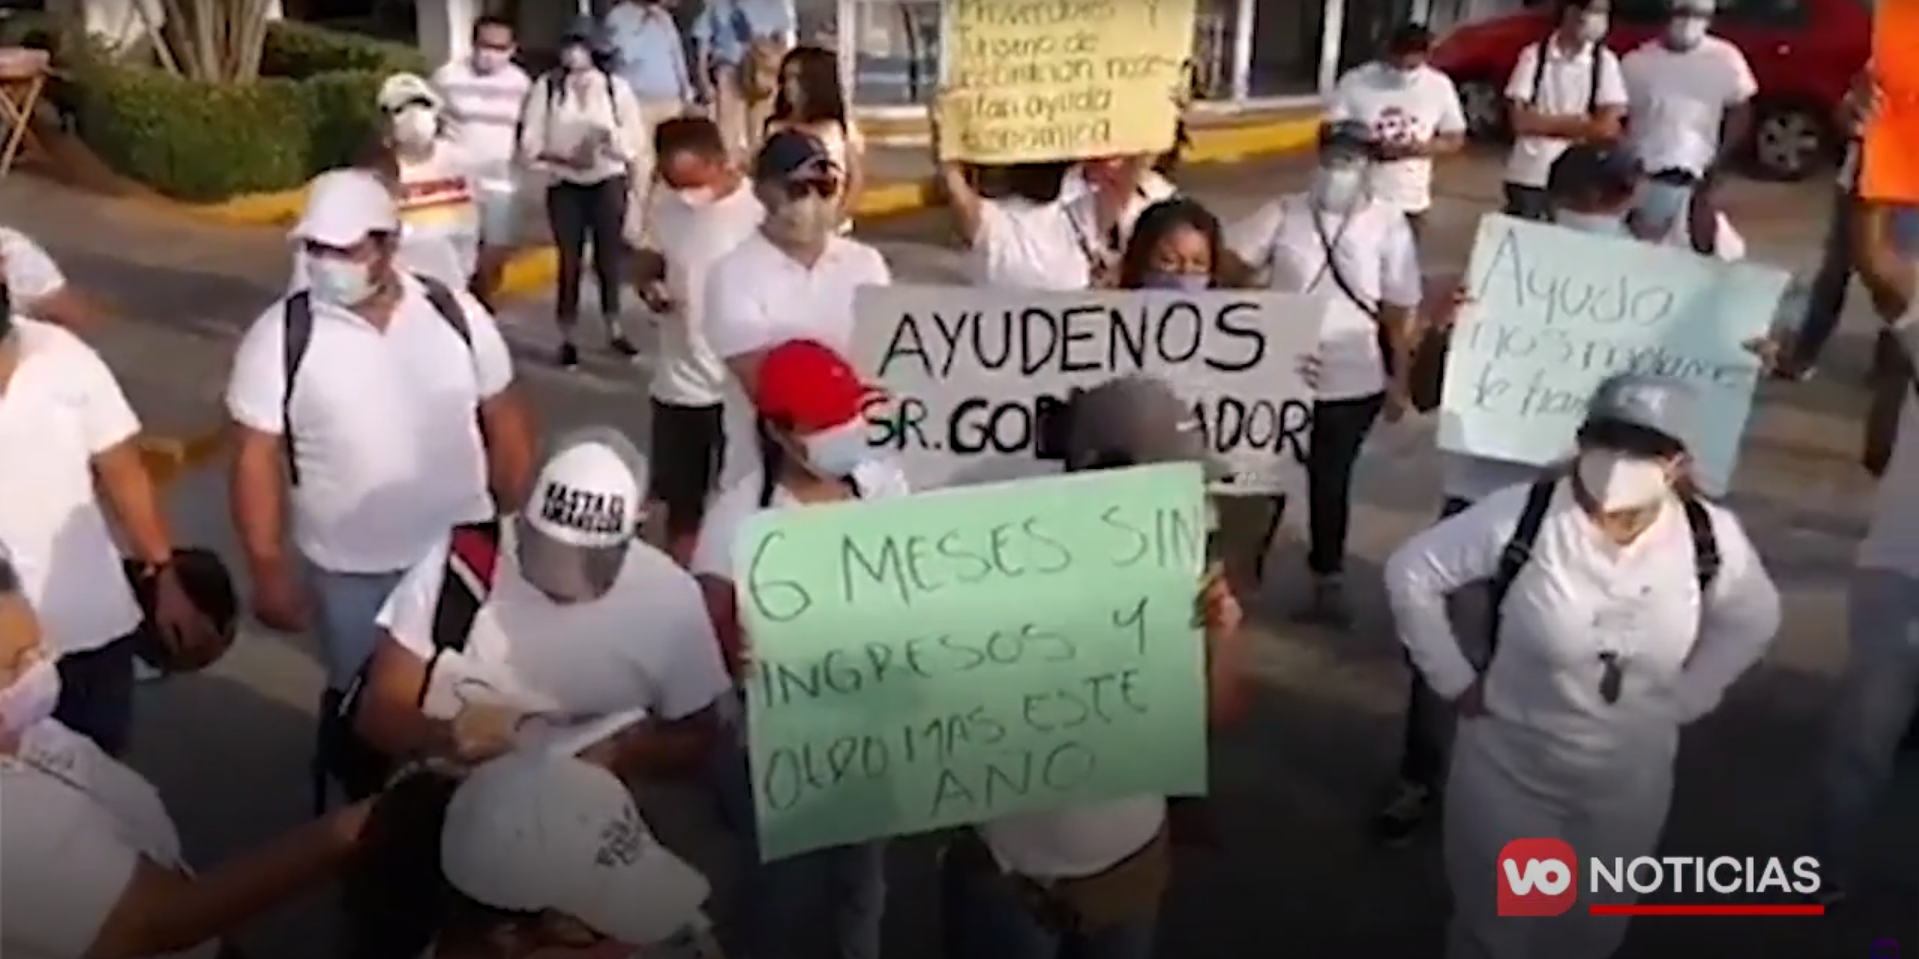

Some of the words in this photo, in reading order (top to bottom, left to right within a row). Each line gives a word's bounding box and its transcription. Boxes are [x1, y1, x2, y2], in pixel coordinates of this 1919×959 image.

[877, 301, 1266, 378] AYUDENOS
[747, 528, 811, 622] 6
[841, 515, 1072, 607] MESES
[1100, 503, 1200, 568] SIN
[759, 623, 1077, 709] INGRESOS
[1023, 669, 1149, 732] ESTE
